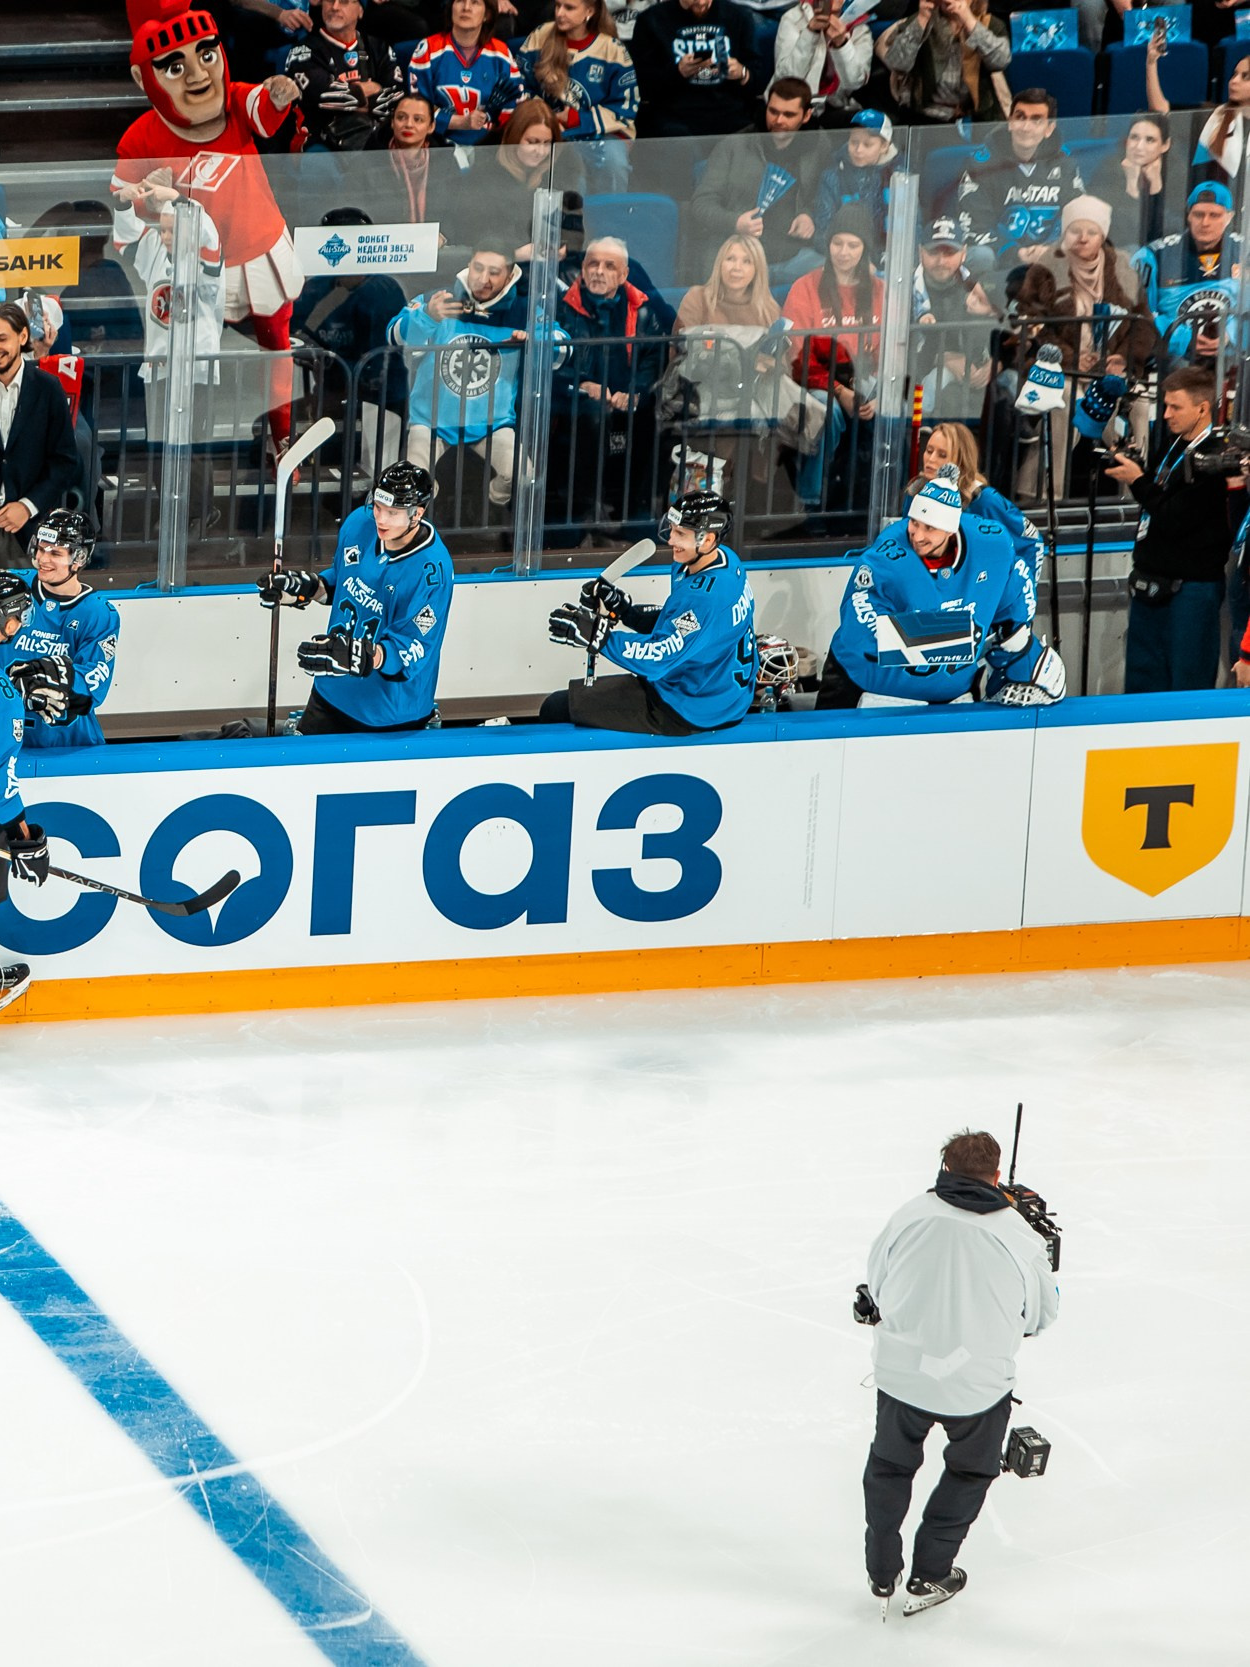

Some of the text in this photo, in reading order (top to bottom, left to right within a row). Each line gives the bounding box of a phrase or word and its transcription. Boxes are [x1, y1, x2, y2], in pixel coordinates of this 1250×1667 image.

[357, 235, 391, 244] ФОНБЕТ
[357, 244, 415, 254] НЕДЕЛЯ ЗВЕЗД
[356, 254, 408, 264] ХОККЕЯ 2025
[423, 560, 444, 587] 21
[689, 575, 716, 593] 91
[31, 629, 61, 641] FONBET
[16, 848, 48, 860] CC
[63, 871, 130, 899] VAPOR
